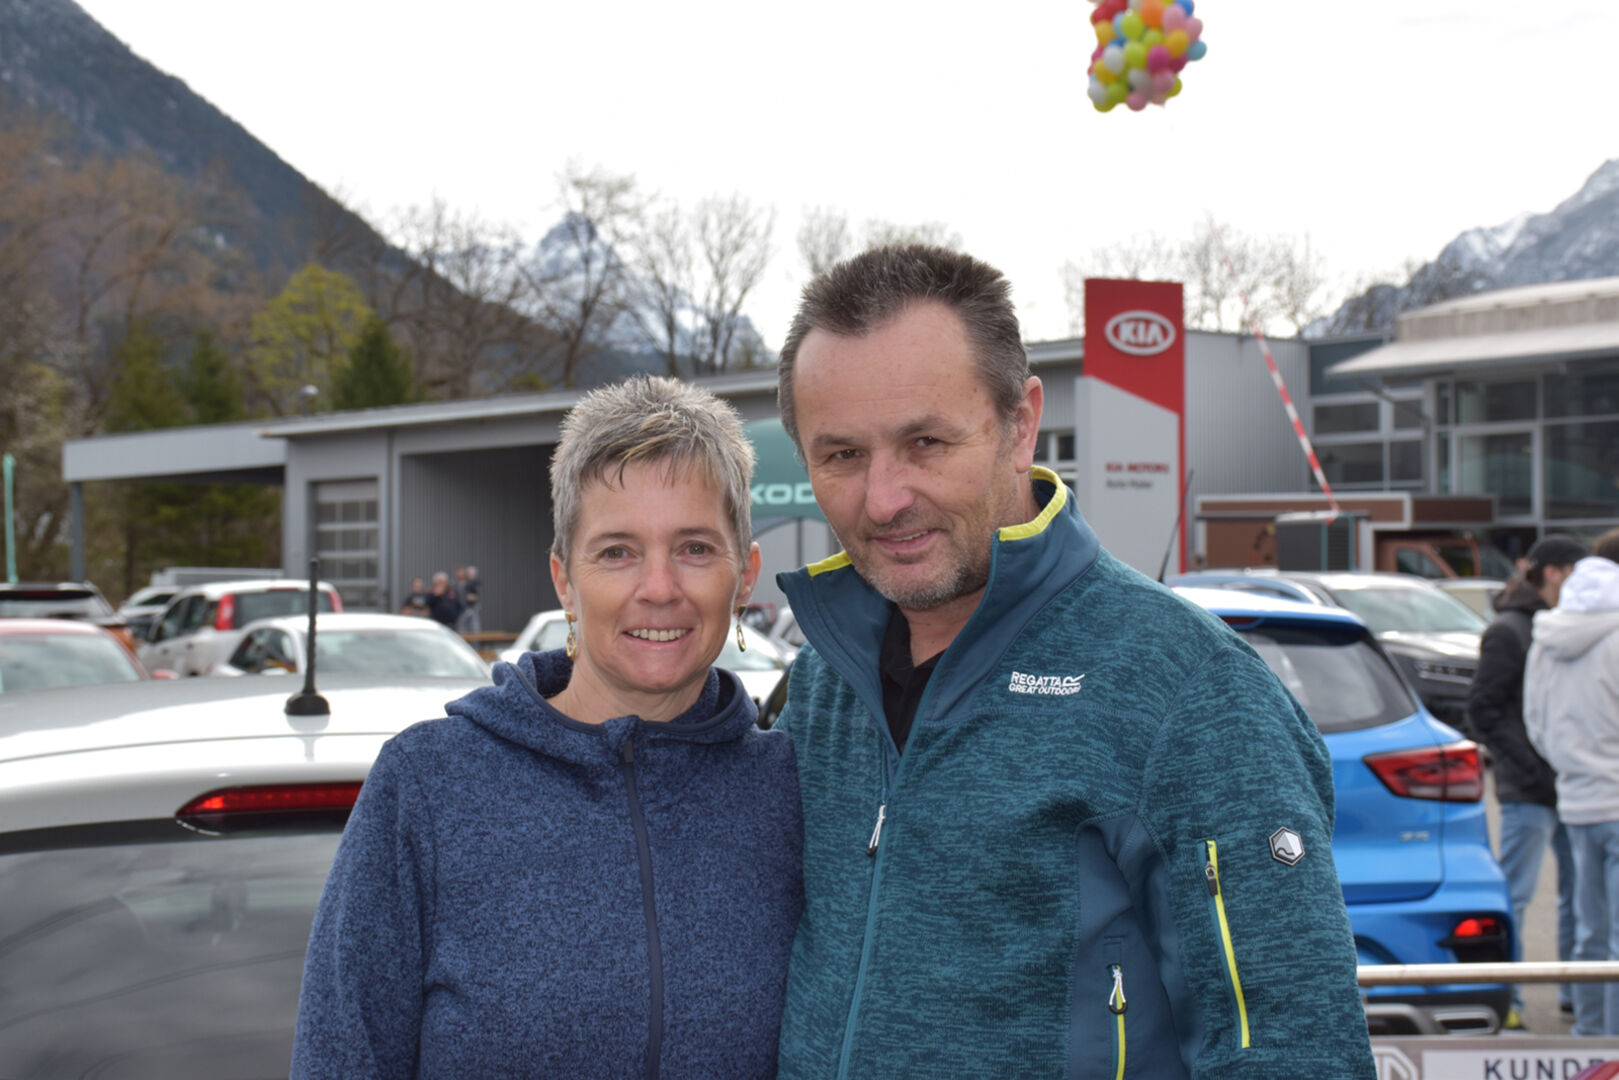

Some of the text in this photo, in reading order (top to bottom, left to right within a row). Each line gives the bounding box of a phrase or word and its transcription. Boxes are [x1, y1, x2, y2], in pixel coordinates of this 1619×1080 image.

[1118, 321, 1164, 345] KIA
[1008, 683, 1038, 694] GREAT
[1010, 671, 1062, 687] REGATTA
[1484, 1058, 1606, 1080] KUND
